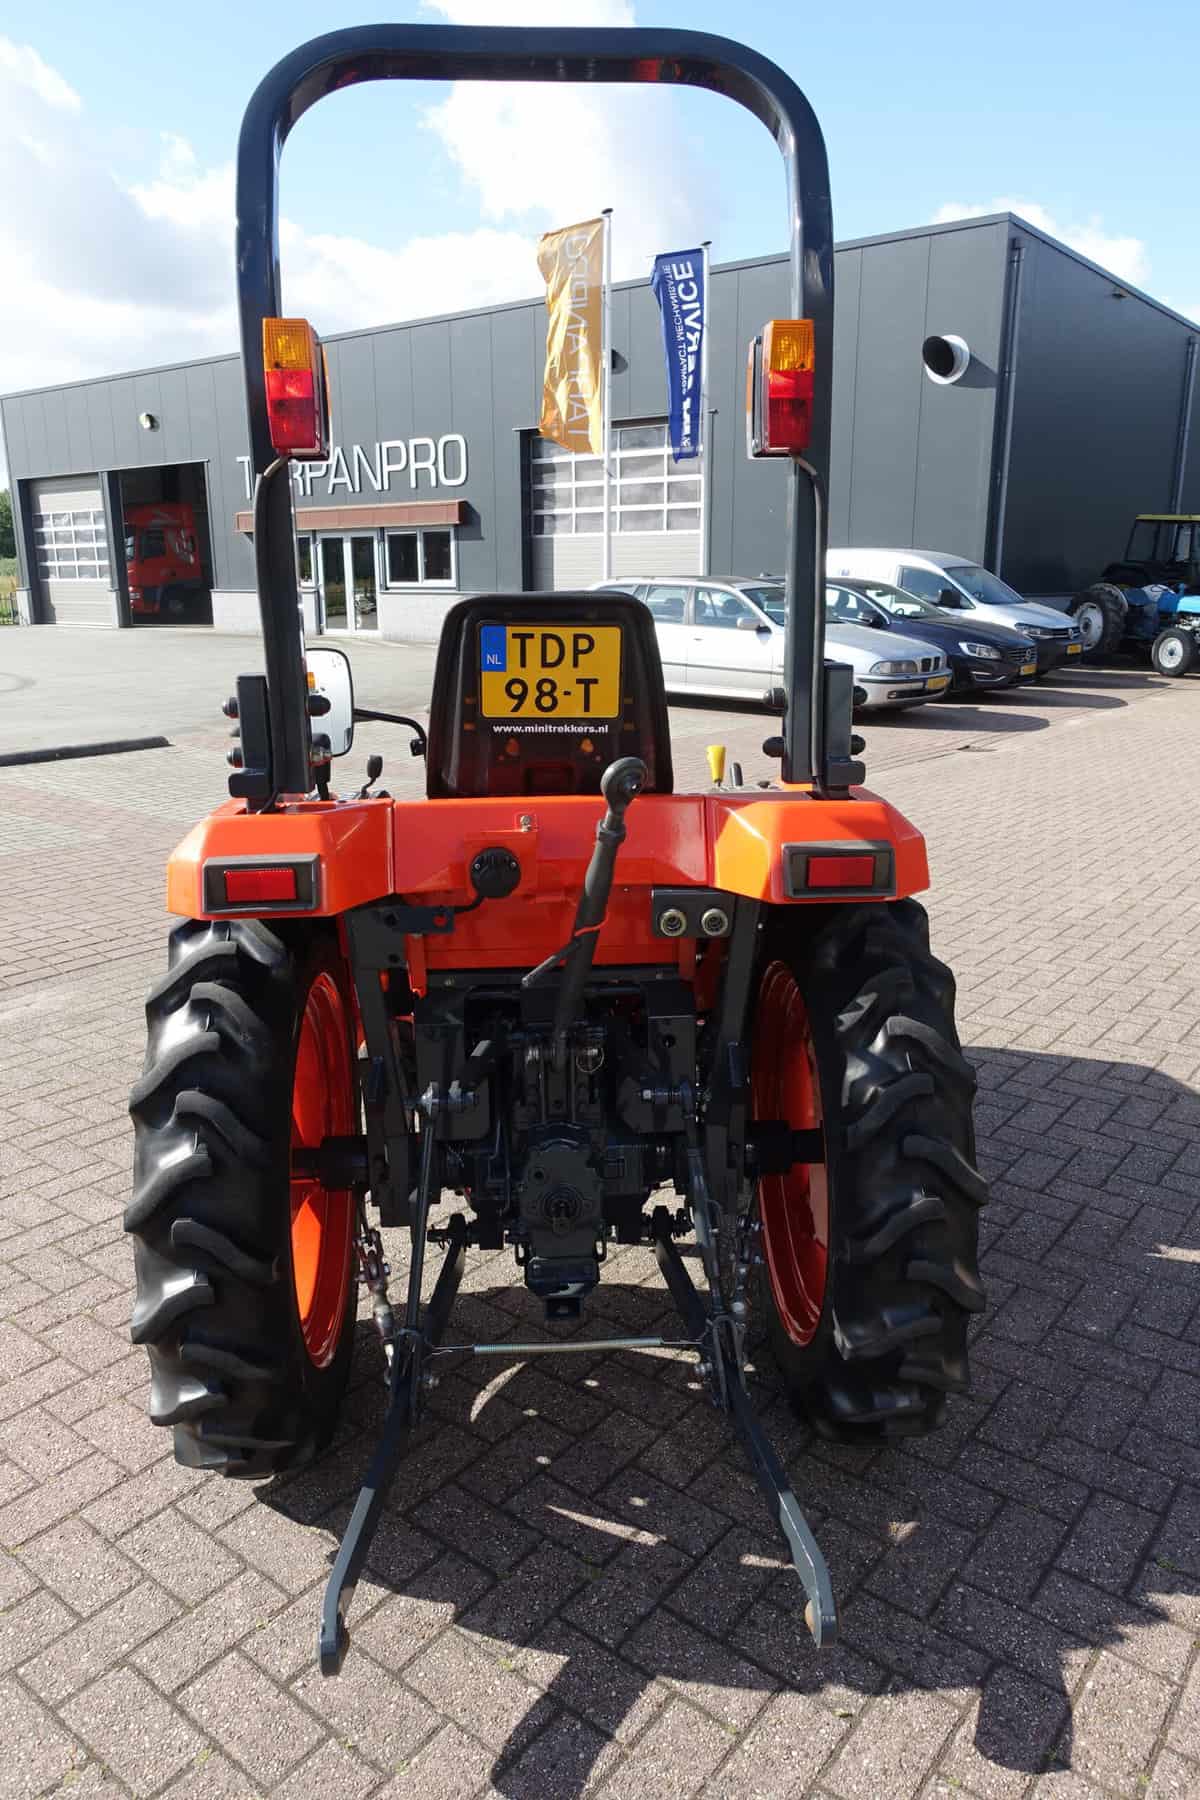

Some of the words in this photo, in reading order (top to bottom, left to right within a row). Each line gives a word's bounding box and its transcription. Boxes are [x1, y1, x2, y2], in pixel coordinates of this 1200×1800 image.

[236, 434, 468, 499] TRPANPRO
[487, 654, 501, 664] NL
[511, 633, 595, 668] TDP
[505, 678, 599, 712] 98-T
[492, 724, 609, 733] www.minitrekkers.nl
